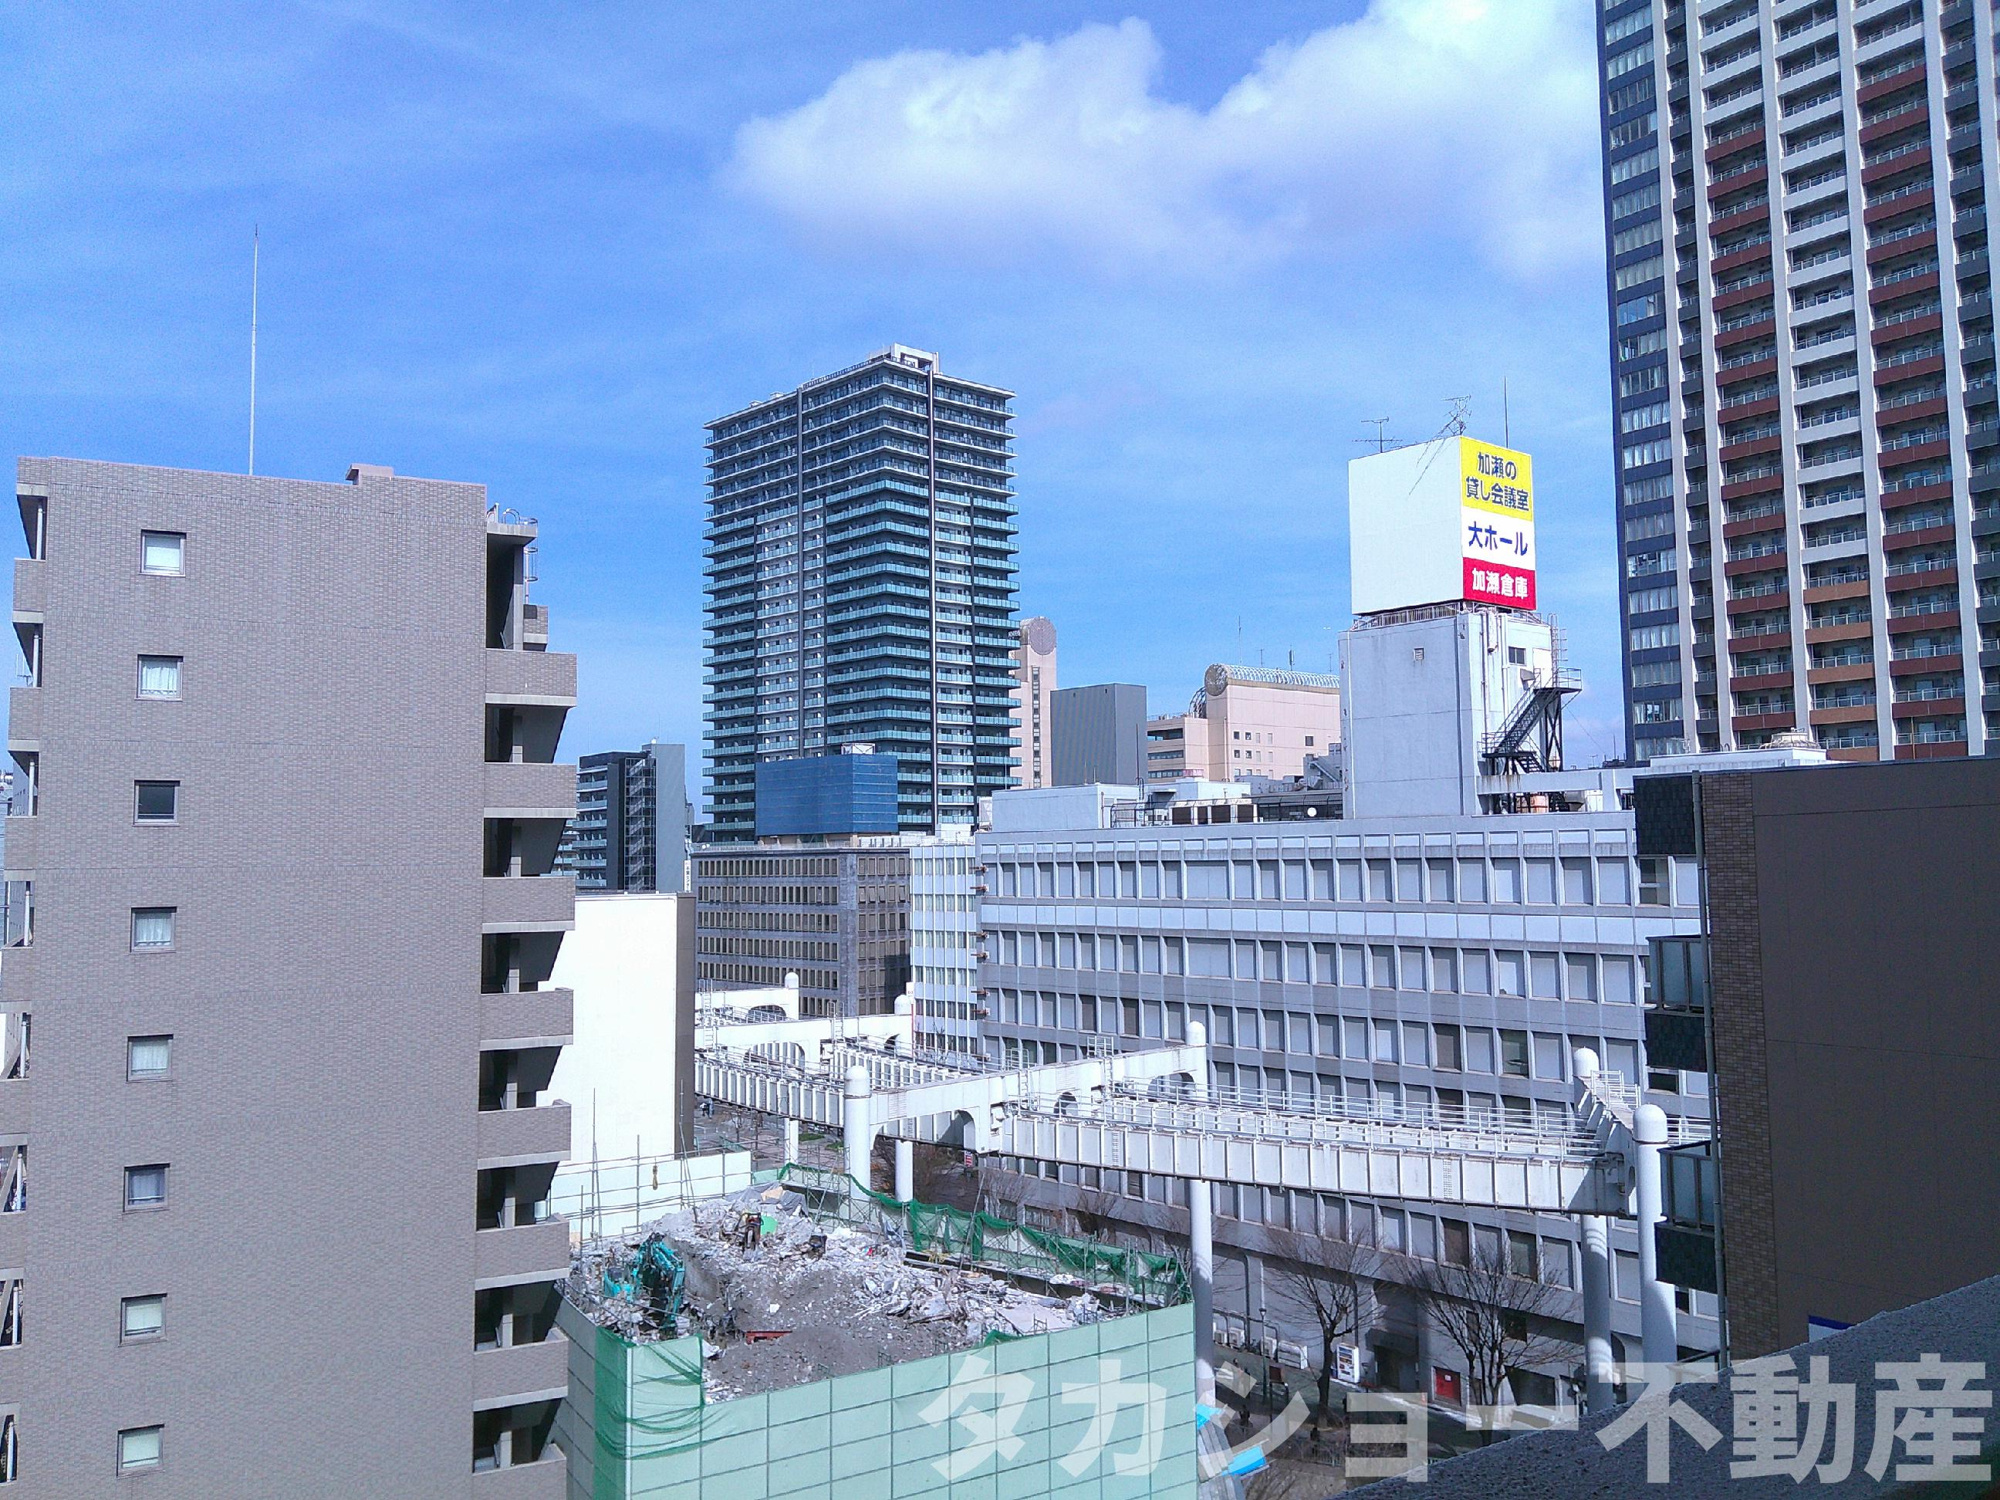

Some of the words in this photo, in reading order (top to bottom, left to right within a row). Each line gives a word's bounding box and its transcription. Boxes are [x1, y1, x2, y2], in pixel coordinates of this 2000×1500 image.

[1478, 452, 1517, 480] 加瀬の
[1466, 476, 1529, 511] 貸し会議室
[1468, 521, 1528, 556] 大ホール
[1472, 568, 1528, 599] 加瀬倉庫
